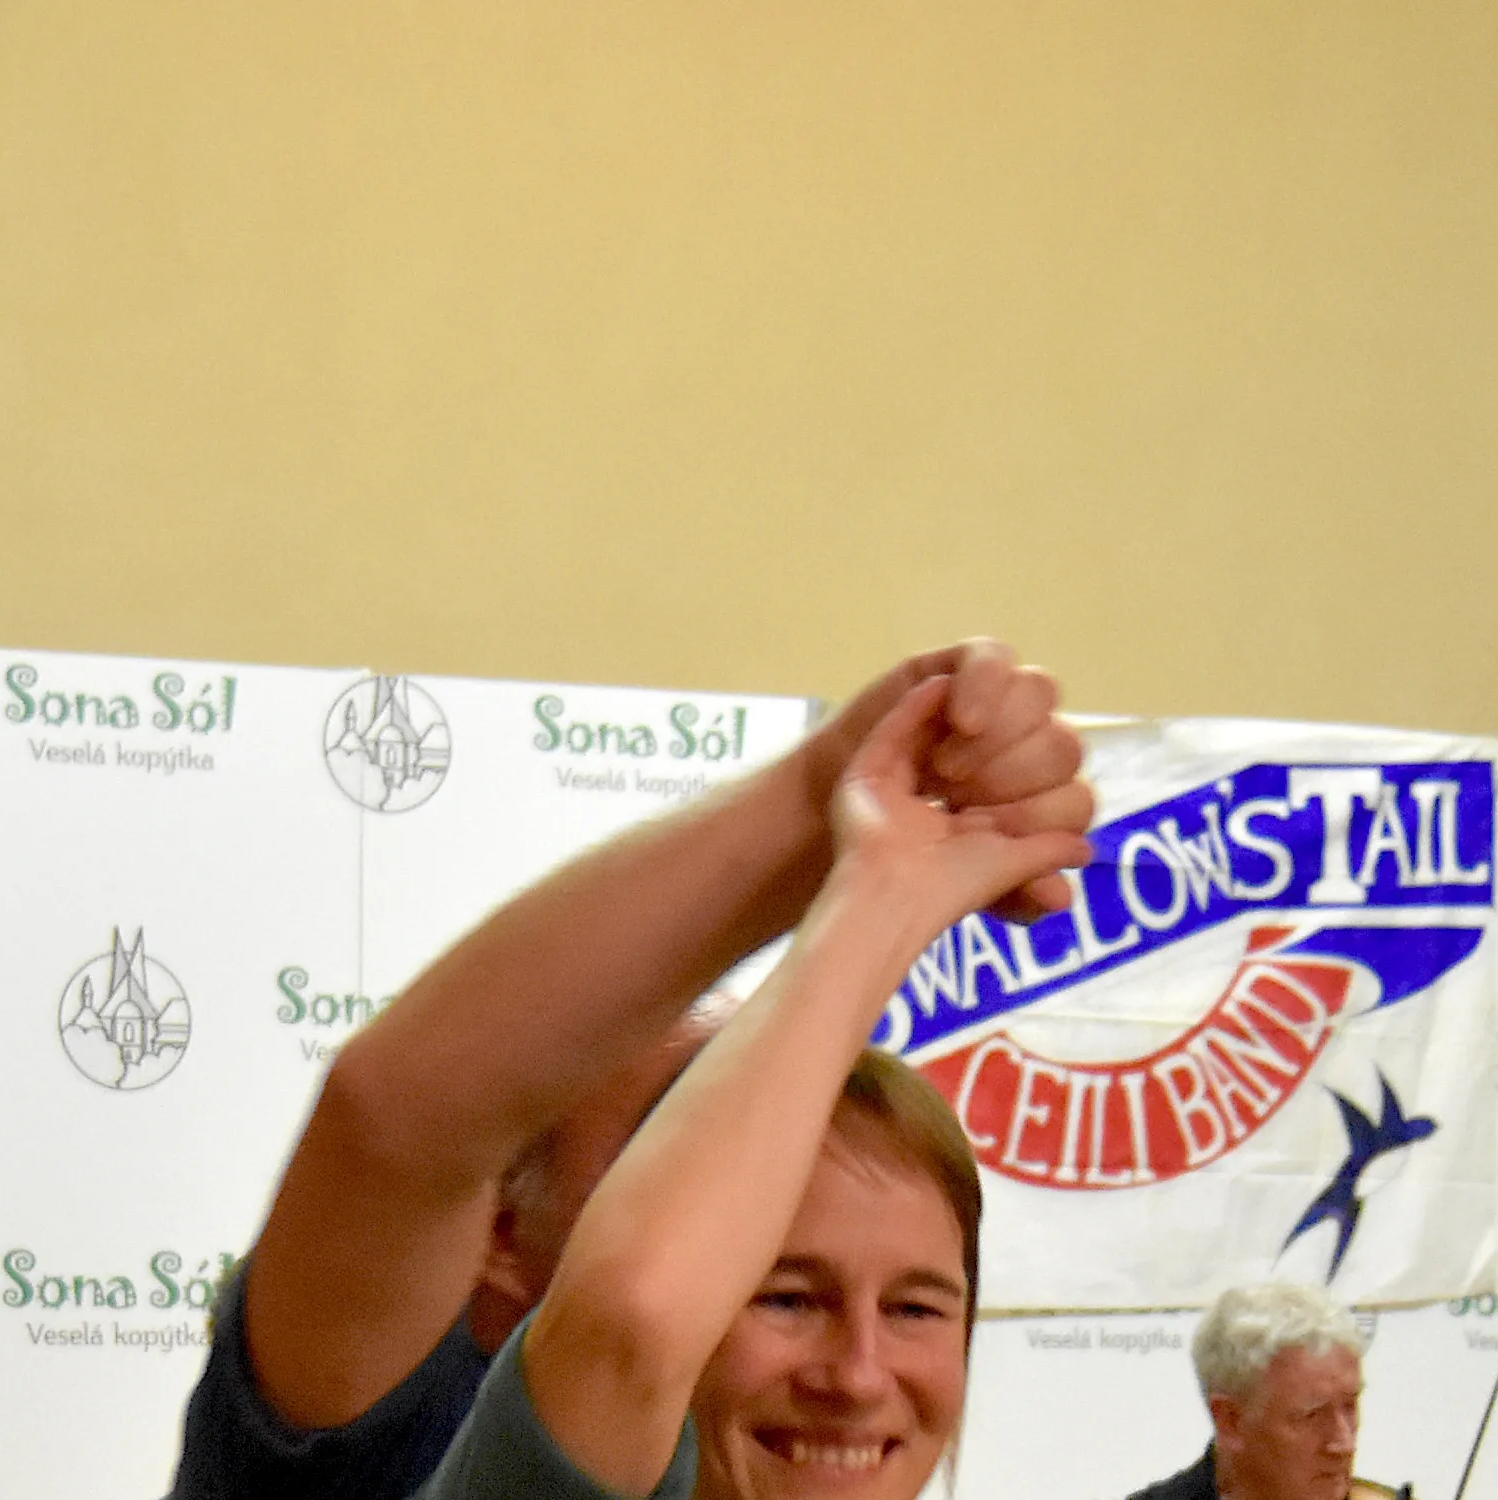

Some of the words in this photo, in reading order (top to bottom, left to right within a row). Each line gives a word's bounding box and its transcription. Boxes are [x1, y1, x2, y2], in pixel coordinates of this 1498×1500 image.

[4, 664, 140, 729] Sona
[151, 673, 237, 735] Sól
[533, 694, 659, 758] Sona
[668, 702, 747, 762] Sól
[27, 738, 107, 767] Veselá
[117, 742, 215, 776] kopýtka
[554, 766, 627, 793] Veselá
[1288, 767, 1491, 904] TAIL
[276, 965, 398, 1027] Son
[958, 1038, 1158, 1186] CEILI
[1153, 965, 1338, 1165] BAND
[1, 1248, 138, 1310] Sona
[26, 1322, 104, 1348] Veselá
[1024, 1326, 1093, 1350] Veselá
[1098, 1328, 1183, 1355] kopýtka
